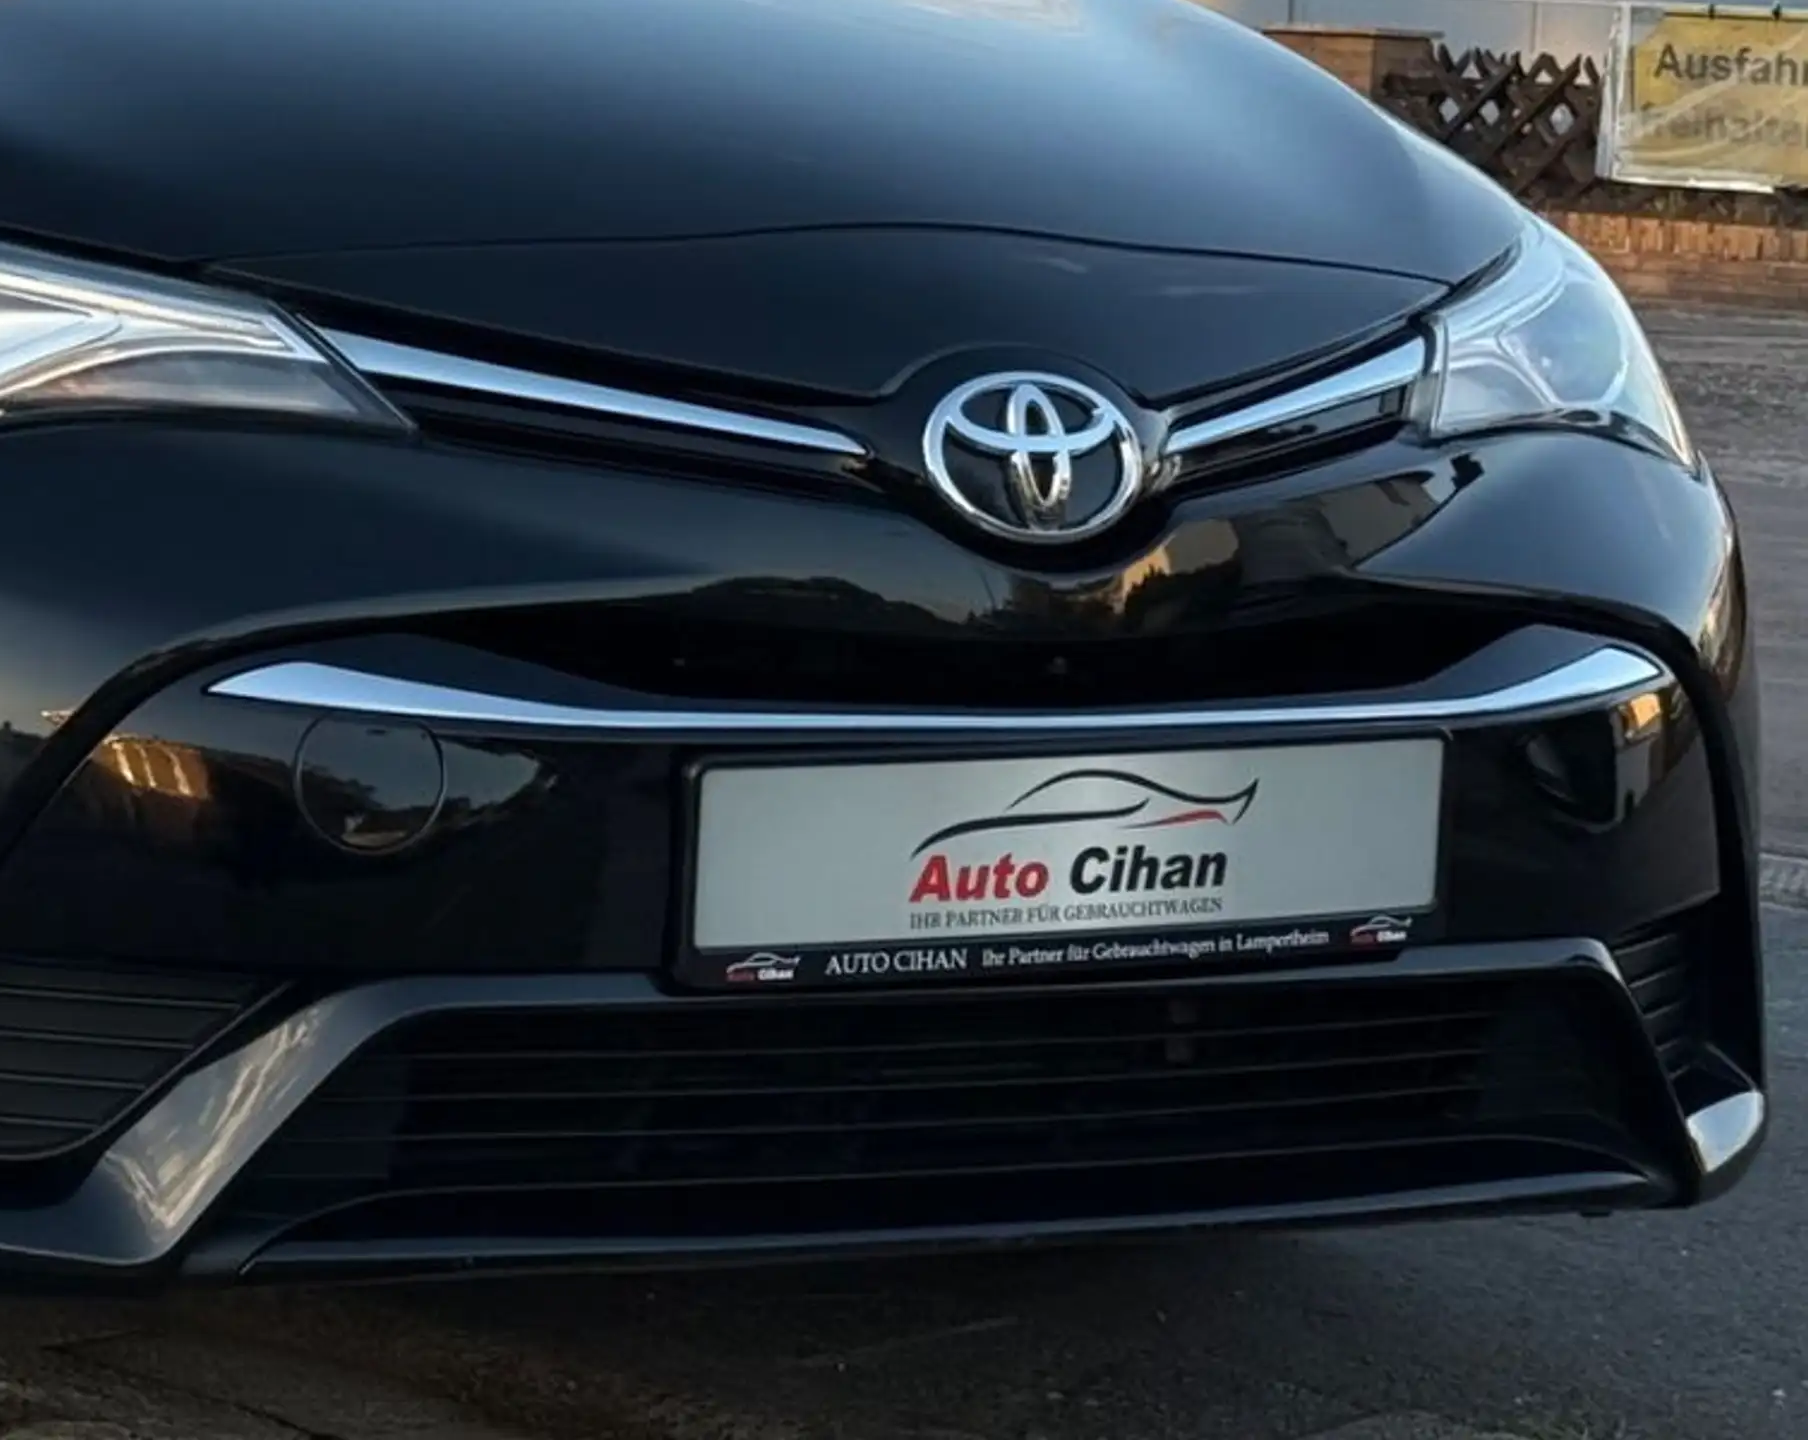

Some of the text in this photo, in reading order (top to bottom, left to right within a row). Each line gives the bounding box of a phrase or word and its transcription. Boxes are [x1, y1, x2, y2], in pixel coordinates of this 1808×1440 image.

[909, 844, 1228, 903] Auto Cihan
[910, 896, 1224, 930] IHR PARTNER FÜR GEBRAUCHTWAGEN
[824, 951, 890, 975] AUTO
[893, 947, 968, 972] CIHAN
[1009, 946, 1064, 966] Partner
[1067, 943, 1090, 961] für
[1093, 937, 1216, 960] Gebrauchtwagen
[1218, 935, 1233, 952] in
